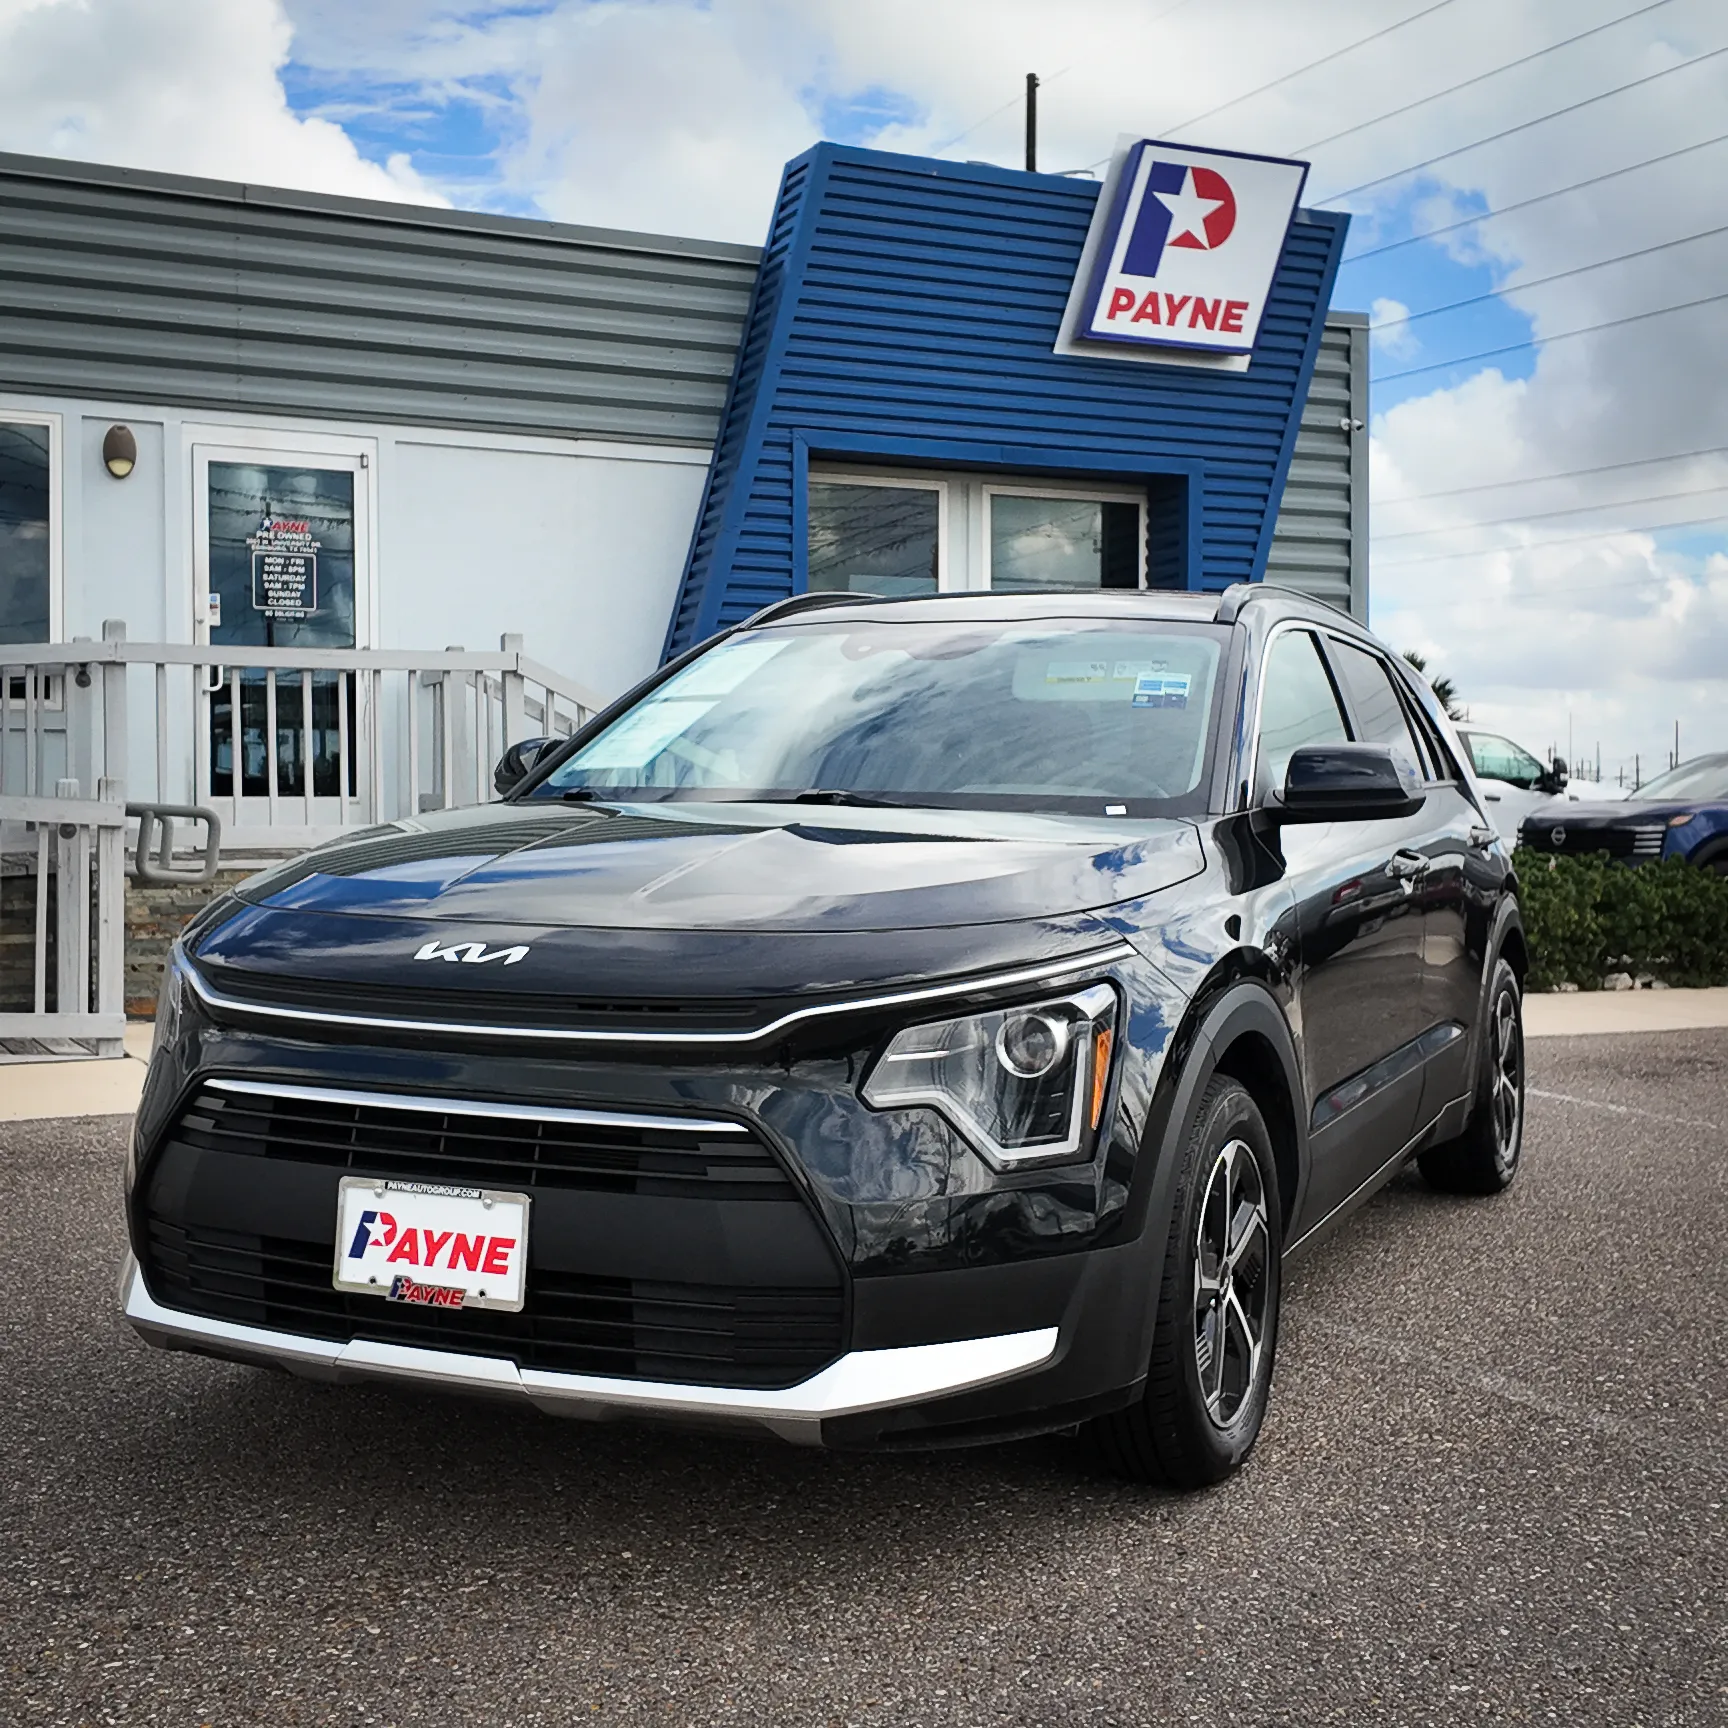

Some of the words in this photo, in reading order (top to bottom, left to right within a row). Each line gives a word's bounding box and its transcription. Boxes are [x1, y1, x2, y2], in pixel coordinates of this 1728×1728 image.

[1107, 287, 1249, 333] PAYNE
[256, 530, 275, 539] PRE
[277, 532, 312, 541] OWNED
[264, 556, 285, 565] MON
[290, 557, 305, 565] FRI
[262, 573, 307, 582] SATURDAY
[267, 590, 302, 598] SUNDAY
[267, 598, 302, 606] CLOSED
[413, 940, 530, 966] KIA
[387, 1180, 480, 1199] PAYNEAUTOGROUP.COM
[348, 1210, 516, 1276] PAYNE
[389, 1276, 465, 1307] PAYNE
